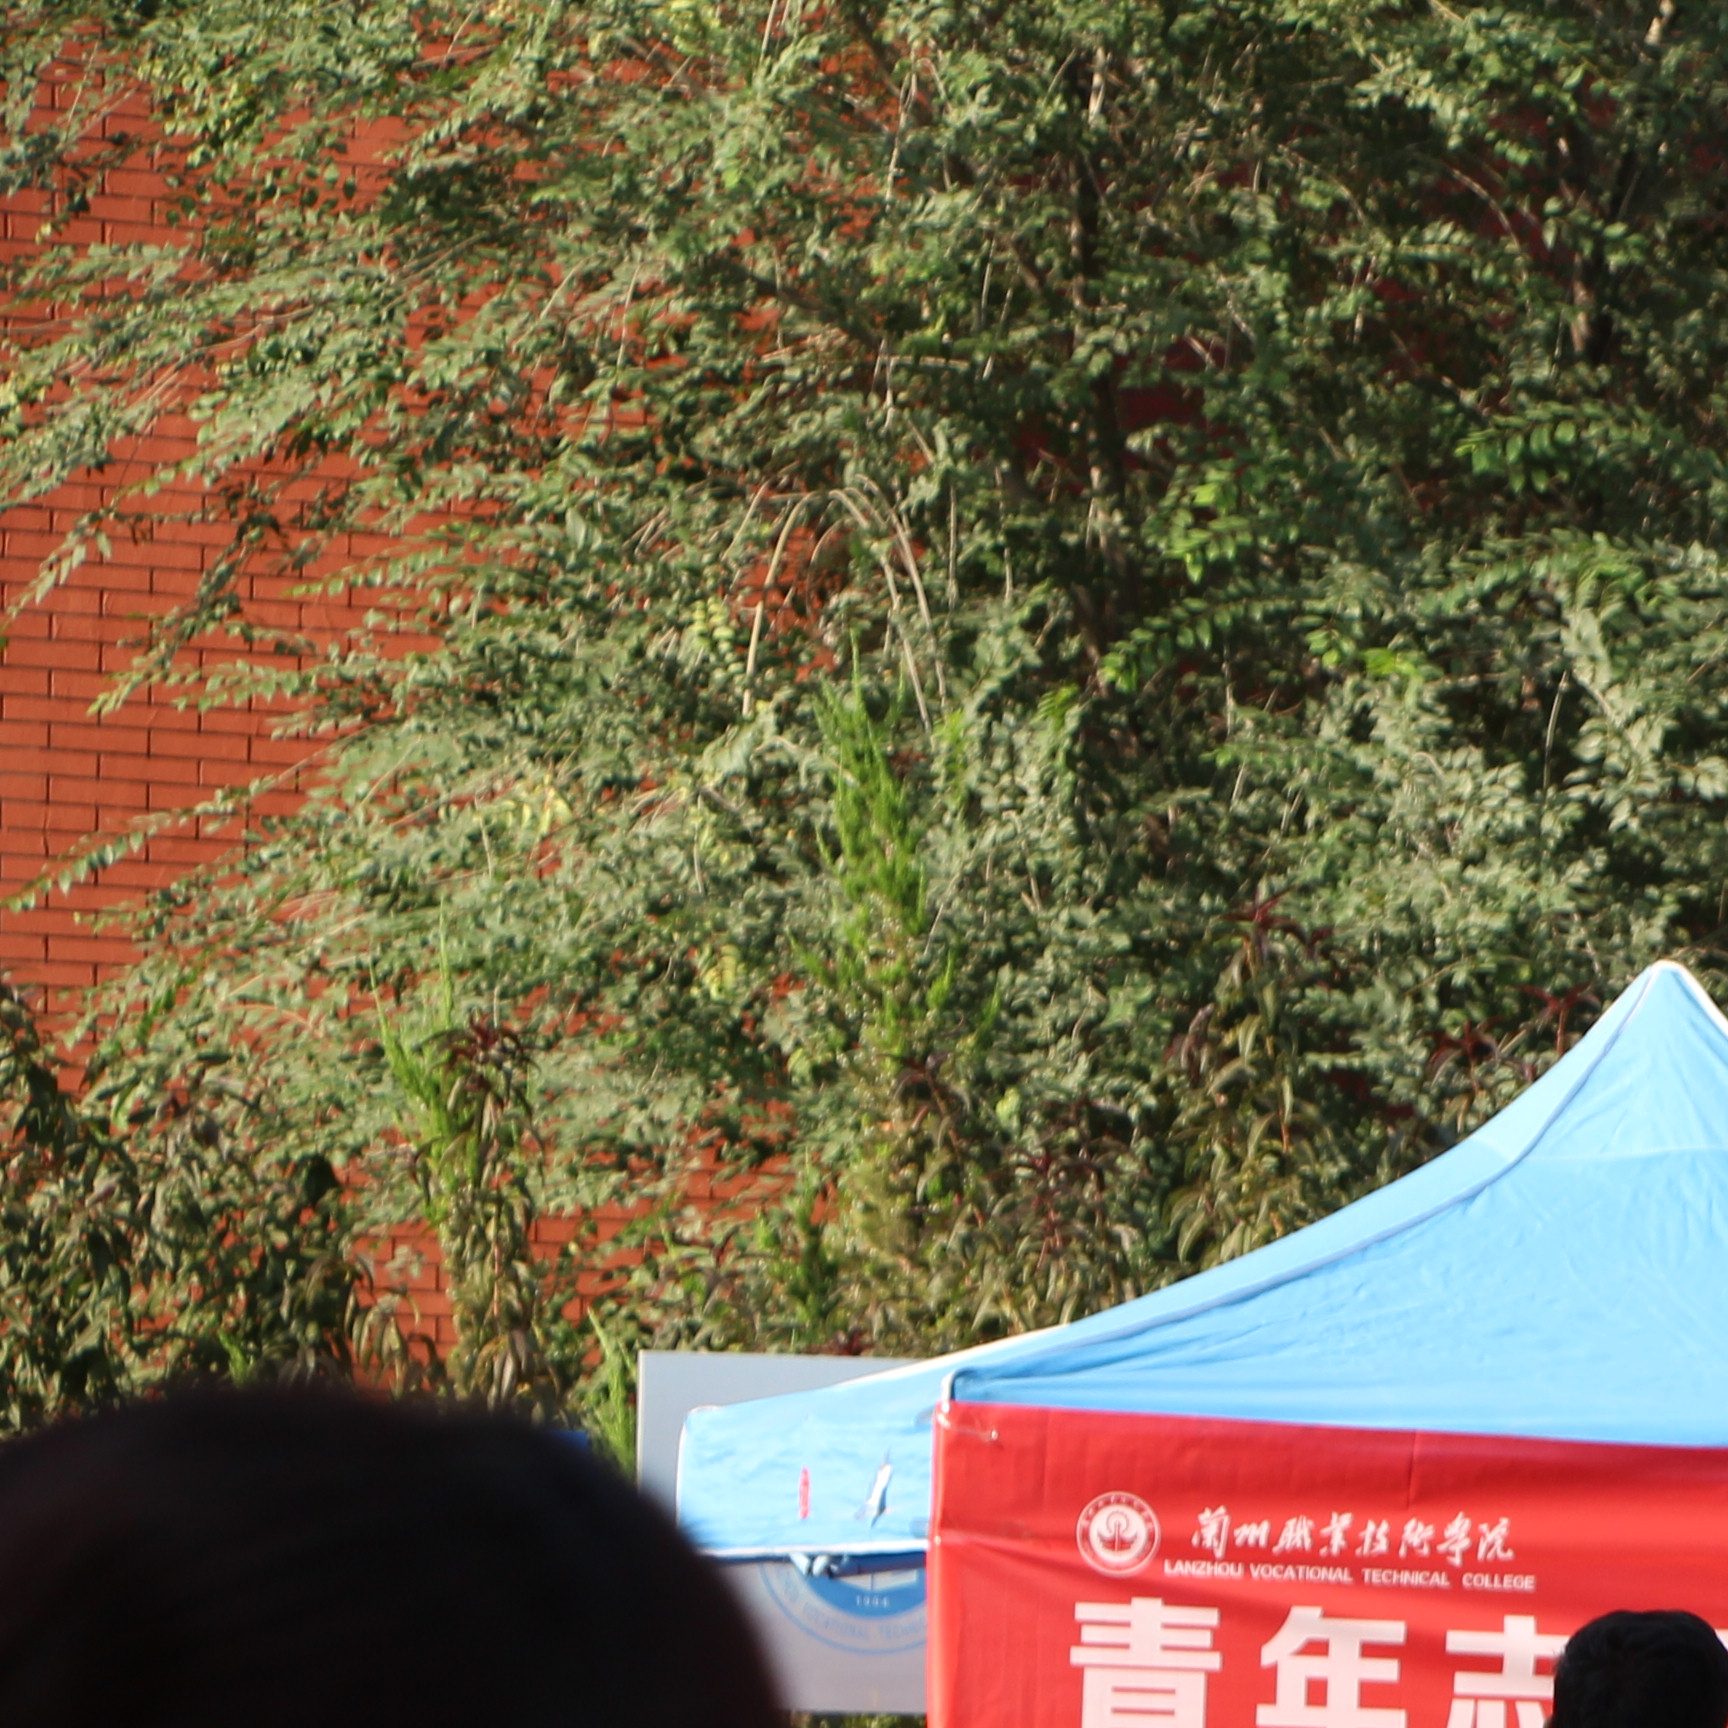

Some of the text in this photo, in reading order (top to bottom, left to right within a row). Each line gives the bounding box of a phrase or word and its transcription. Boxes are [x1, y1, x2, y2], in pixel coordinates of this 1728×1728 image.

[1163, 1559, 1536, 1590] LANZHOU VOCATIONAL TECHNICAL COLLEGE
